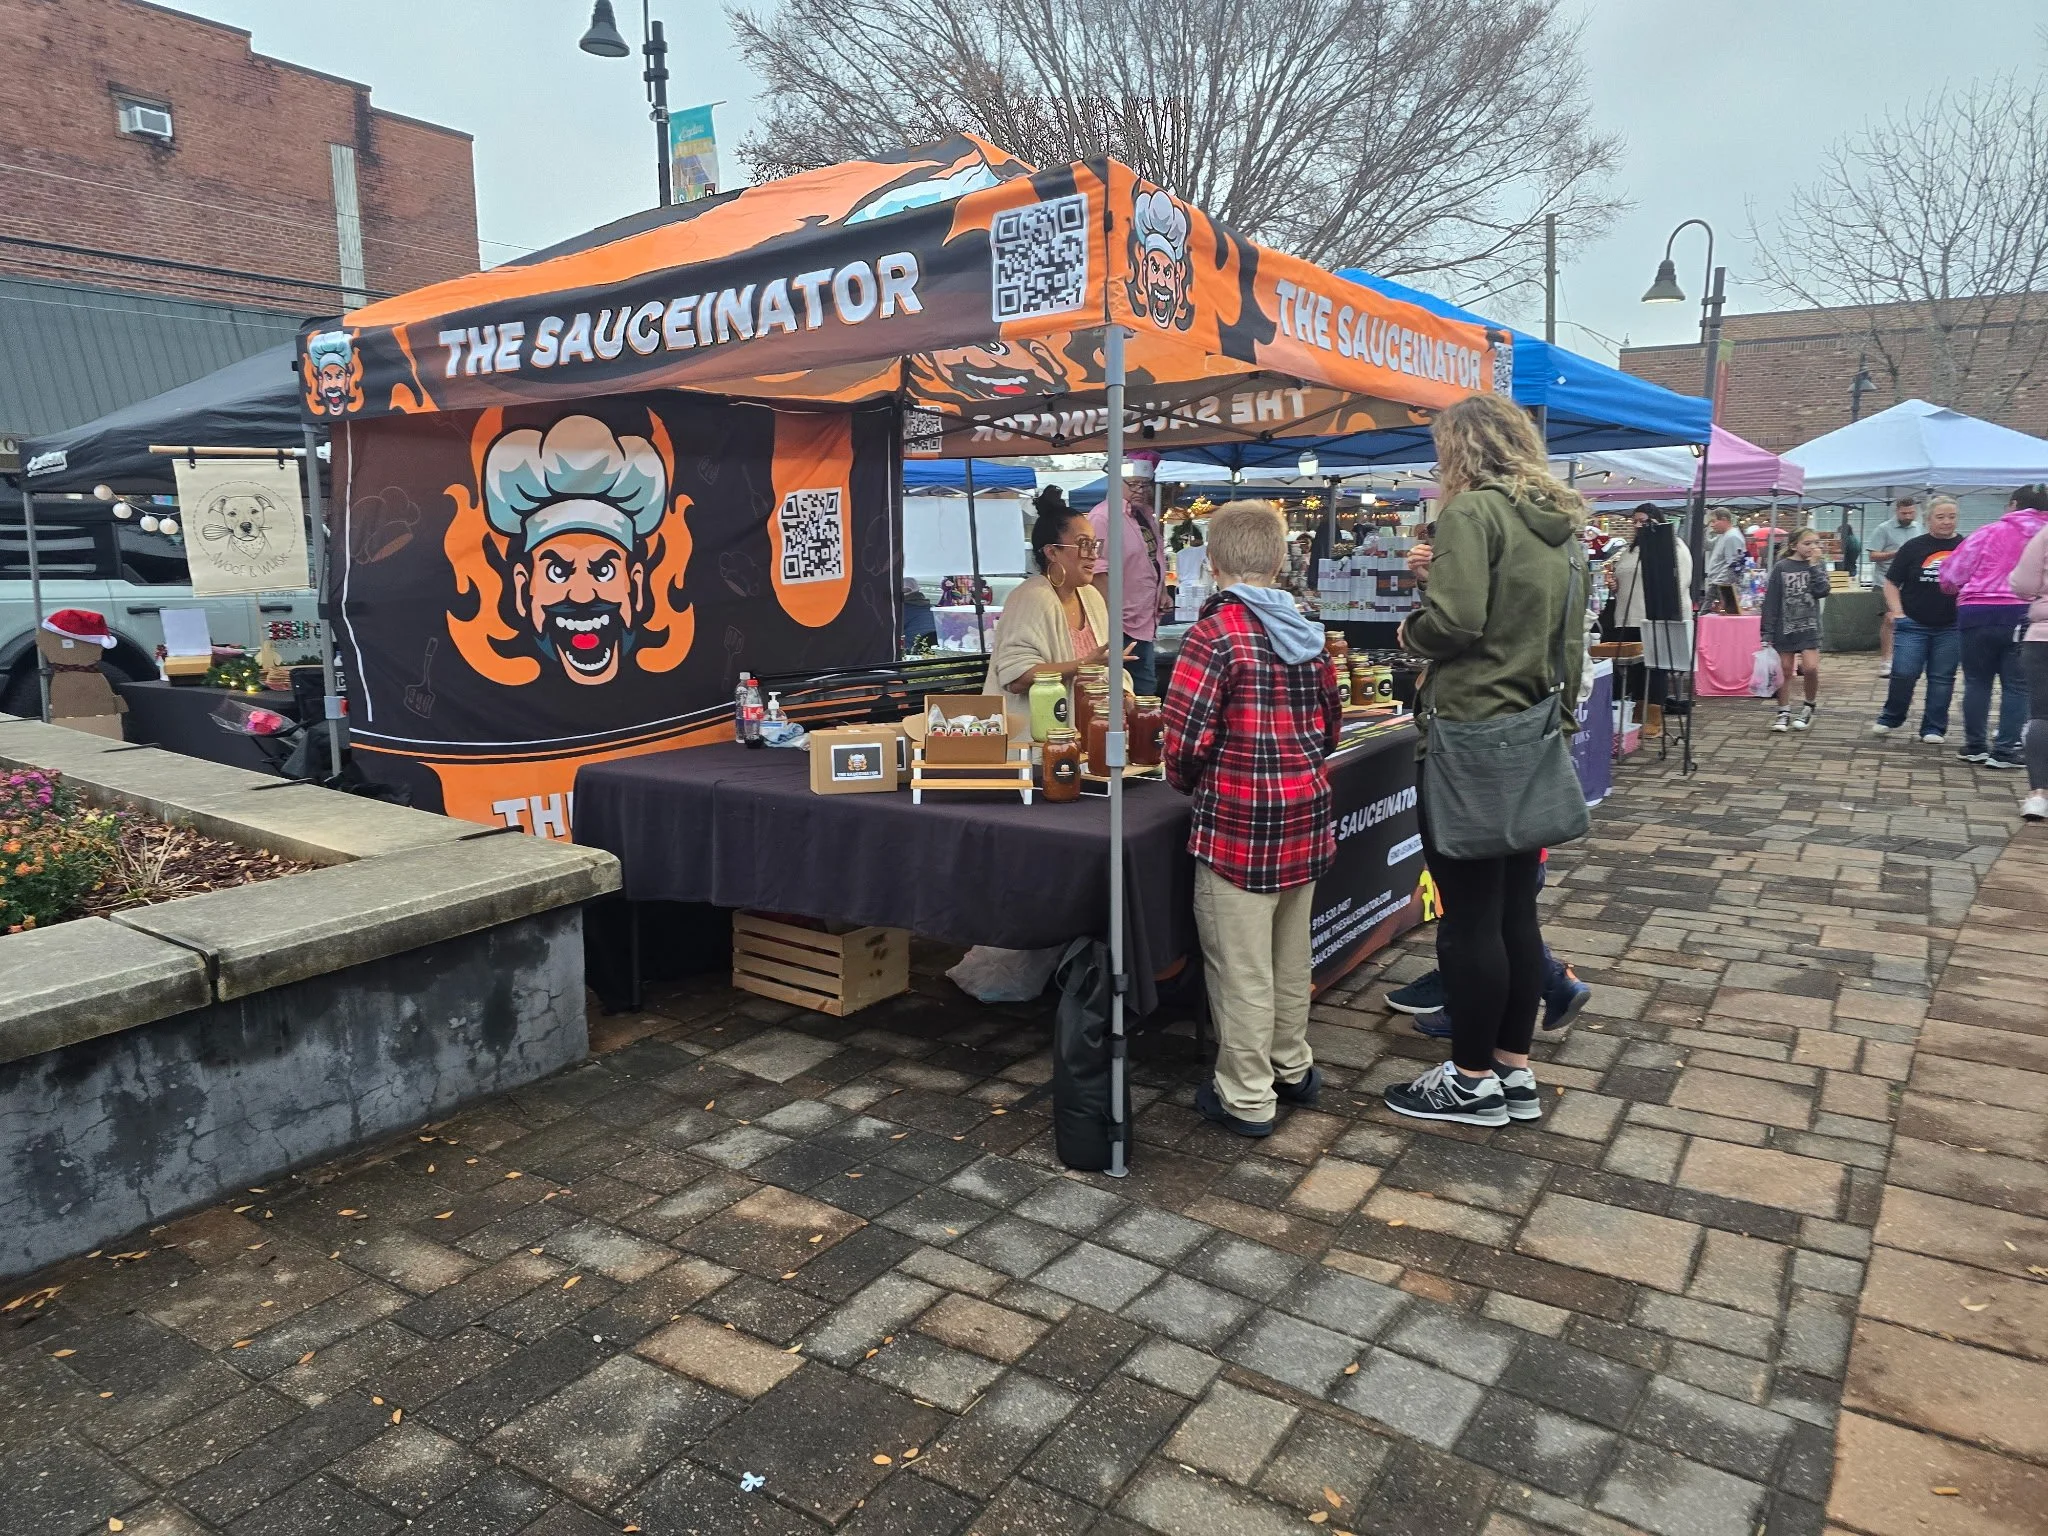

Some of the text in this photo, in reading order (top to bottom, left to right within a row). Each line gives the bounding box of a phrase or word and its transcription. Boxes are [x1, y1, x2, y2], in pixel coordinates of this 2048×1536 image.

[438, 250, 924, 379] THE SAUCEINATOR
[1275, 278, 1481, 391] THE SAUCEINATOR
[249, 565, 257, 577] &
[1338, 785, 1418, 841] SAUCEINATO
